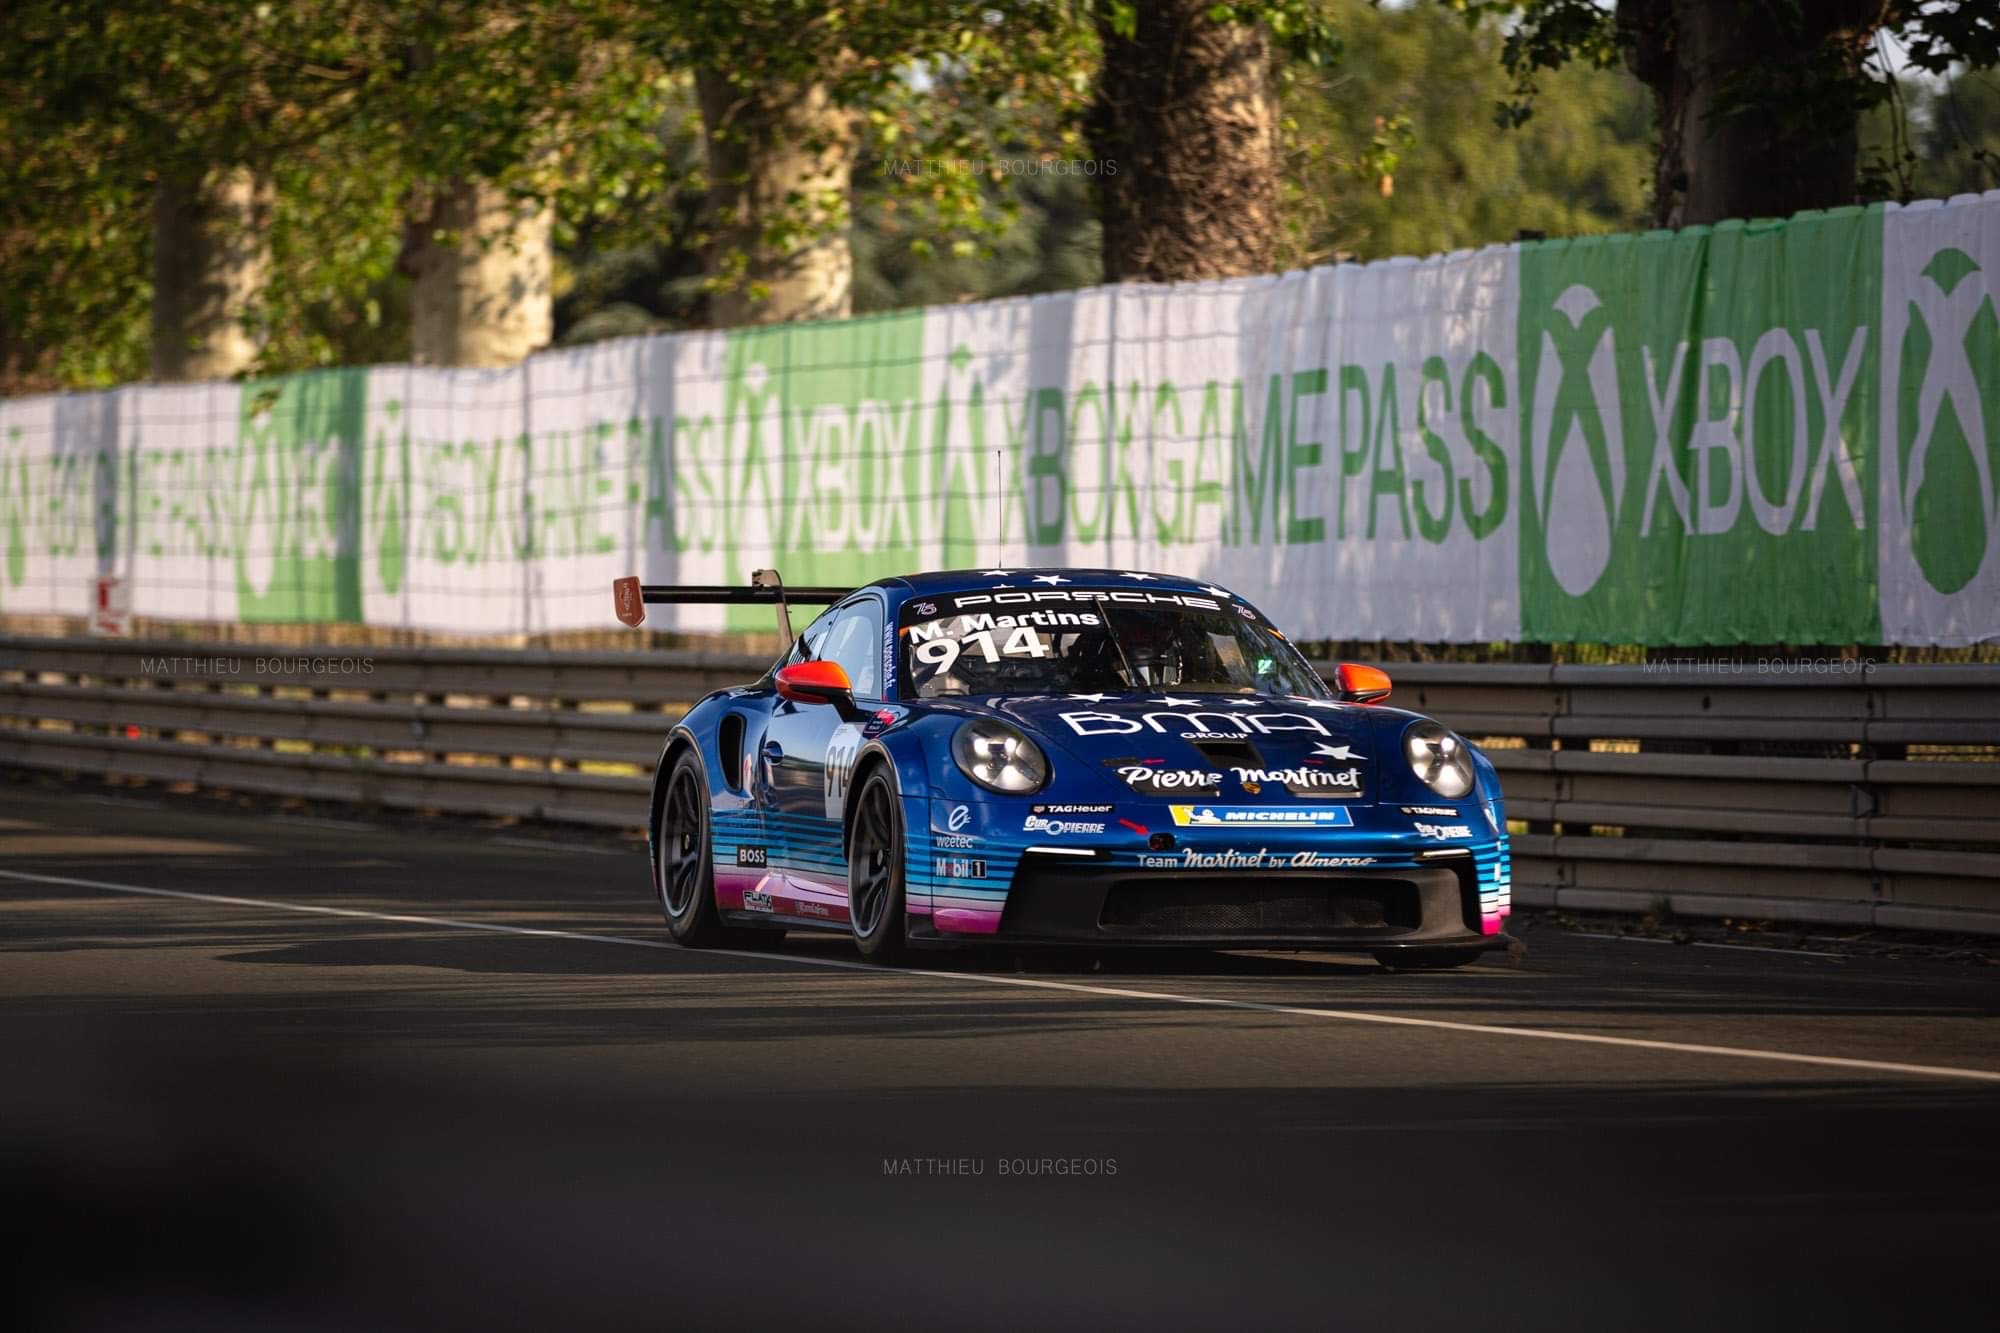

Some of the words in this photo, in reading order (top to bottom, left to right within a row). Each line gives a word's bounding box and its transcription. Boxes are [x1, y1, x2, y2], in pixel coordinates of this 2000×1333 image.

[1640, 326, 1868, 538] XBOX
[1152, 367, 1328, 548] GAME
[1339, 350, 1509, 545] PASS
[789, 399, 914, 555] XBOX
[954, 591, 1221, 611] PORSCHE
[909, 620, 954, 645] M.
[961, 610, 1100, 633] Martins
[916, 626, 1050, 676] 914
[1180, 731, 1248, 739] GROUP
[826, 746, 855, 798] 914
[1116, 766, 1224, 788] Pierre
[1230, 766, 1362, 789] Martinet
[1225, 811, 1336, 821] MICHELIN
[740, 849, 765, 863] BOSS
[1137, 854, 1178, 868] Team
[1182, 848, 1267, 868] Martinet
[1269, 857, 1286, 869] by
[1290, 852, 1377, 867] Almeras
